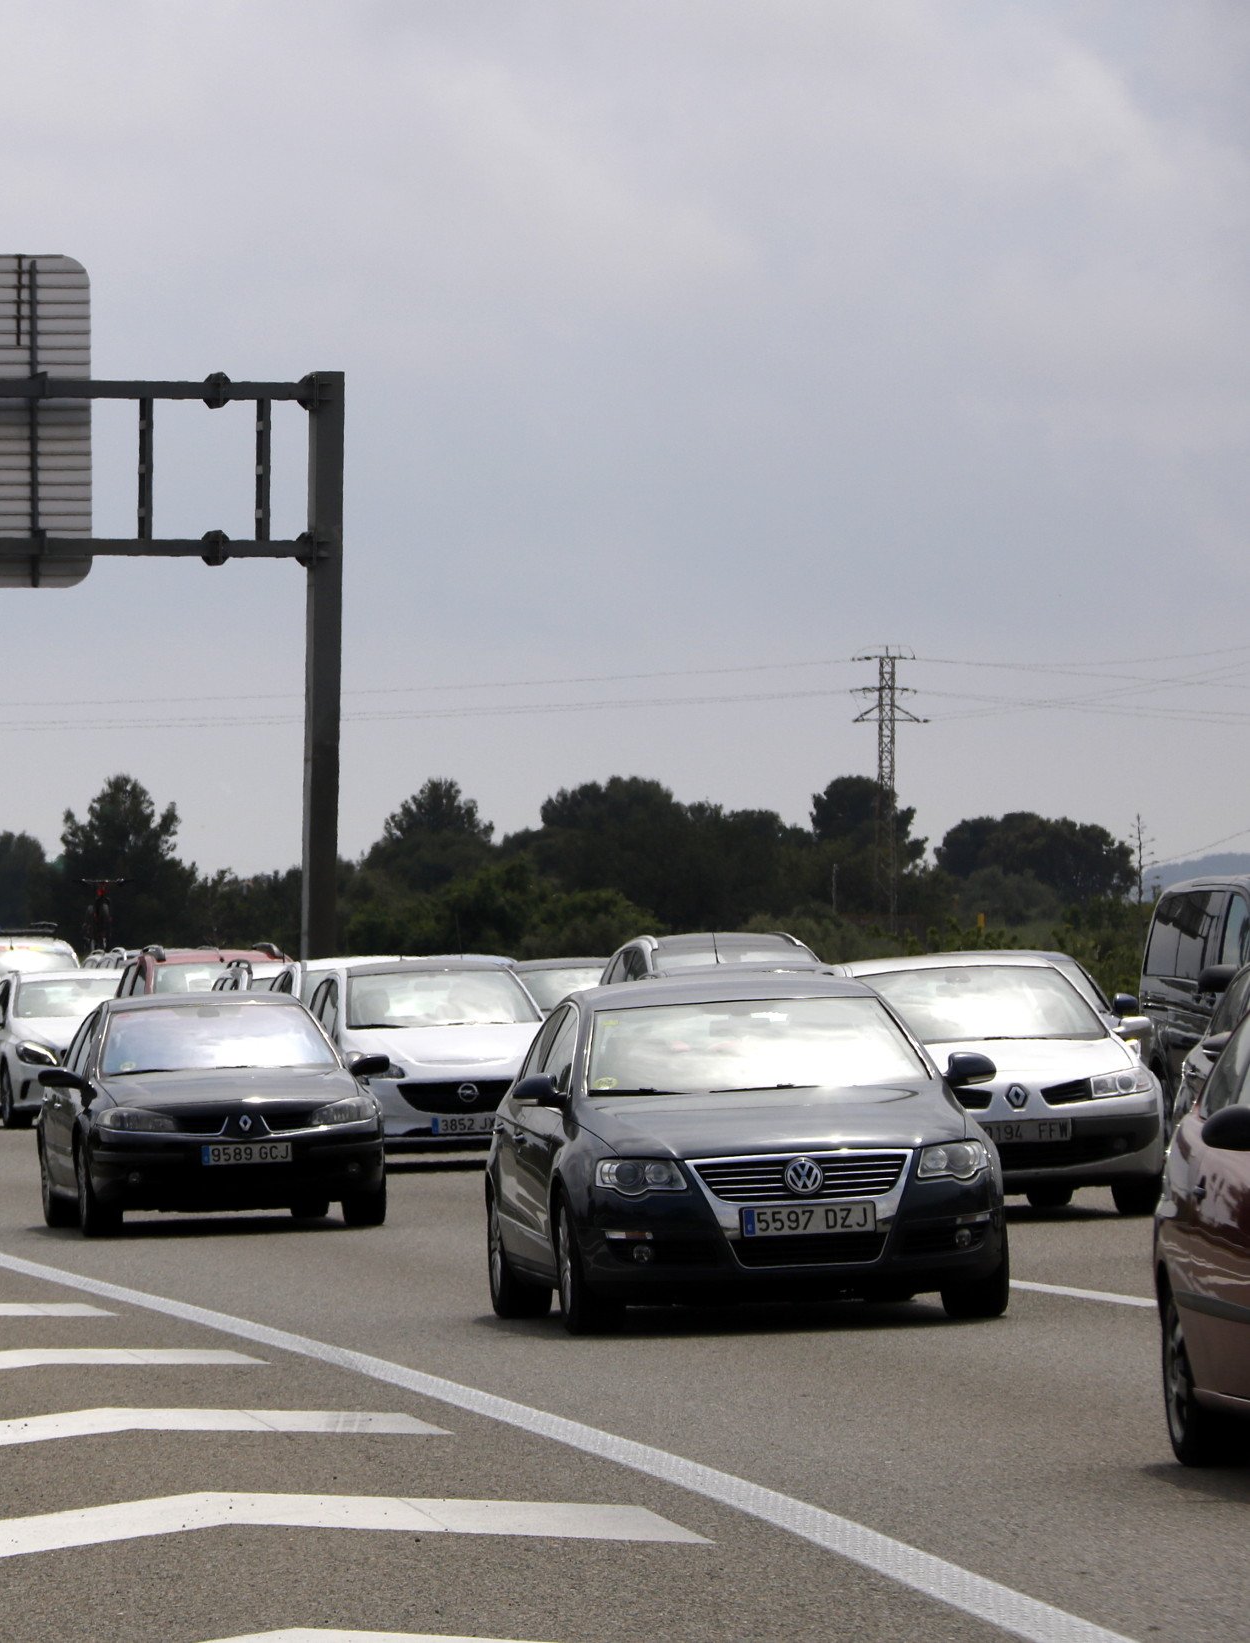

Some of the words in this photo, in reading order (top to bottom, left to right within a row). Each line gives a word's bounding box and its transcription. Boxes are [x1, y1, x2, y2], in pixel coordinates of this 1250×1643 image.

[441, 1118, 475, 1132] 3852
[1038, 1122, 1068, 1139] FFW
[211, 1146, 253, 1162] 9589
[258, 1144, 289, 1160] GCJ
[756, 1209, 815, 1232] 5597
[824, 1206, 868, 1230] DZJ
